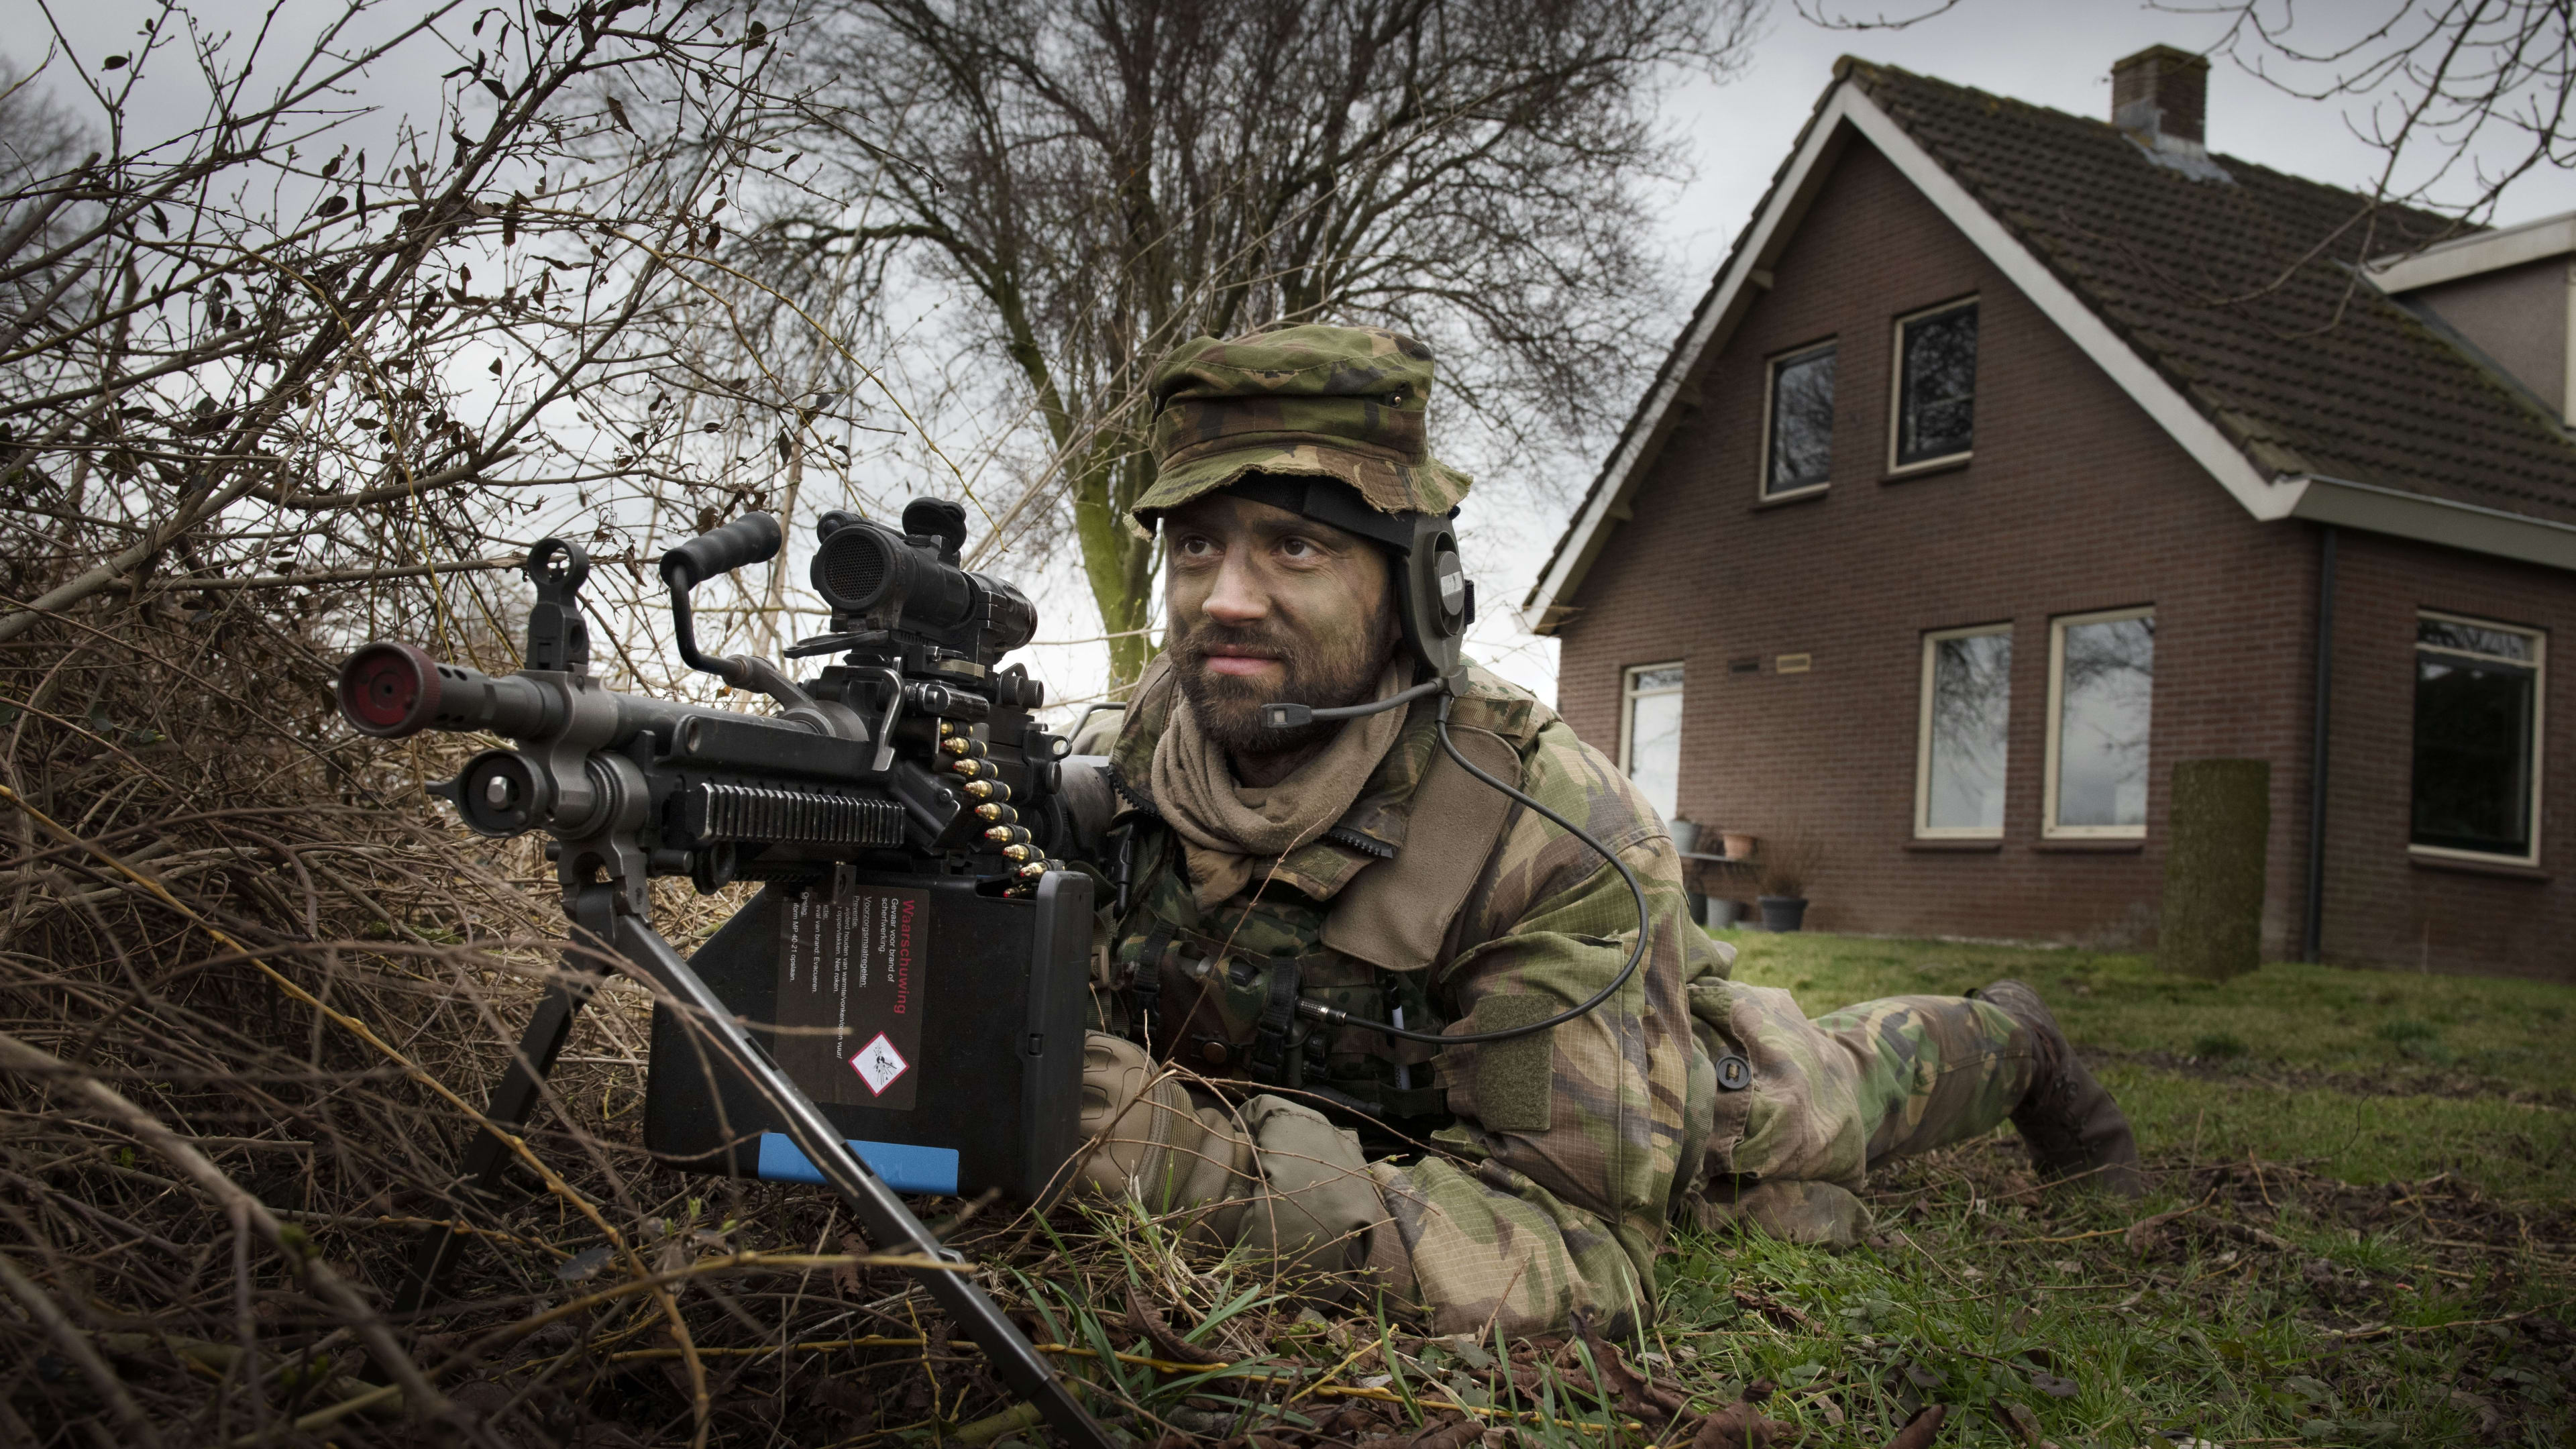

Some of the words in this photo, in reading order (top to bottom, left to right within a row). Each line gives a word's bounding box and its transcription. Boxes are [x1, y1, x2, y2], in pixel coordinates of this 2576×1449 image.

[792, 921, 799, 932] MP
[852, 896, 860, 928] Preventie:
[878, 898, 888, 954] scherfwerking.
[890, 898, 899, 927] Gevaar
[859, 896, 872, 987] Voorzorgsmaatregelen:
[894, 899, 916, 1014] Waarschuwing
[812, 957, 820, 994] Evacueren.
[888, 949, 896, 972] brand
[888, 973, 895, 983] of
